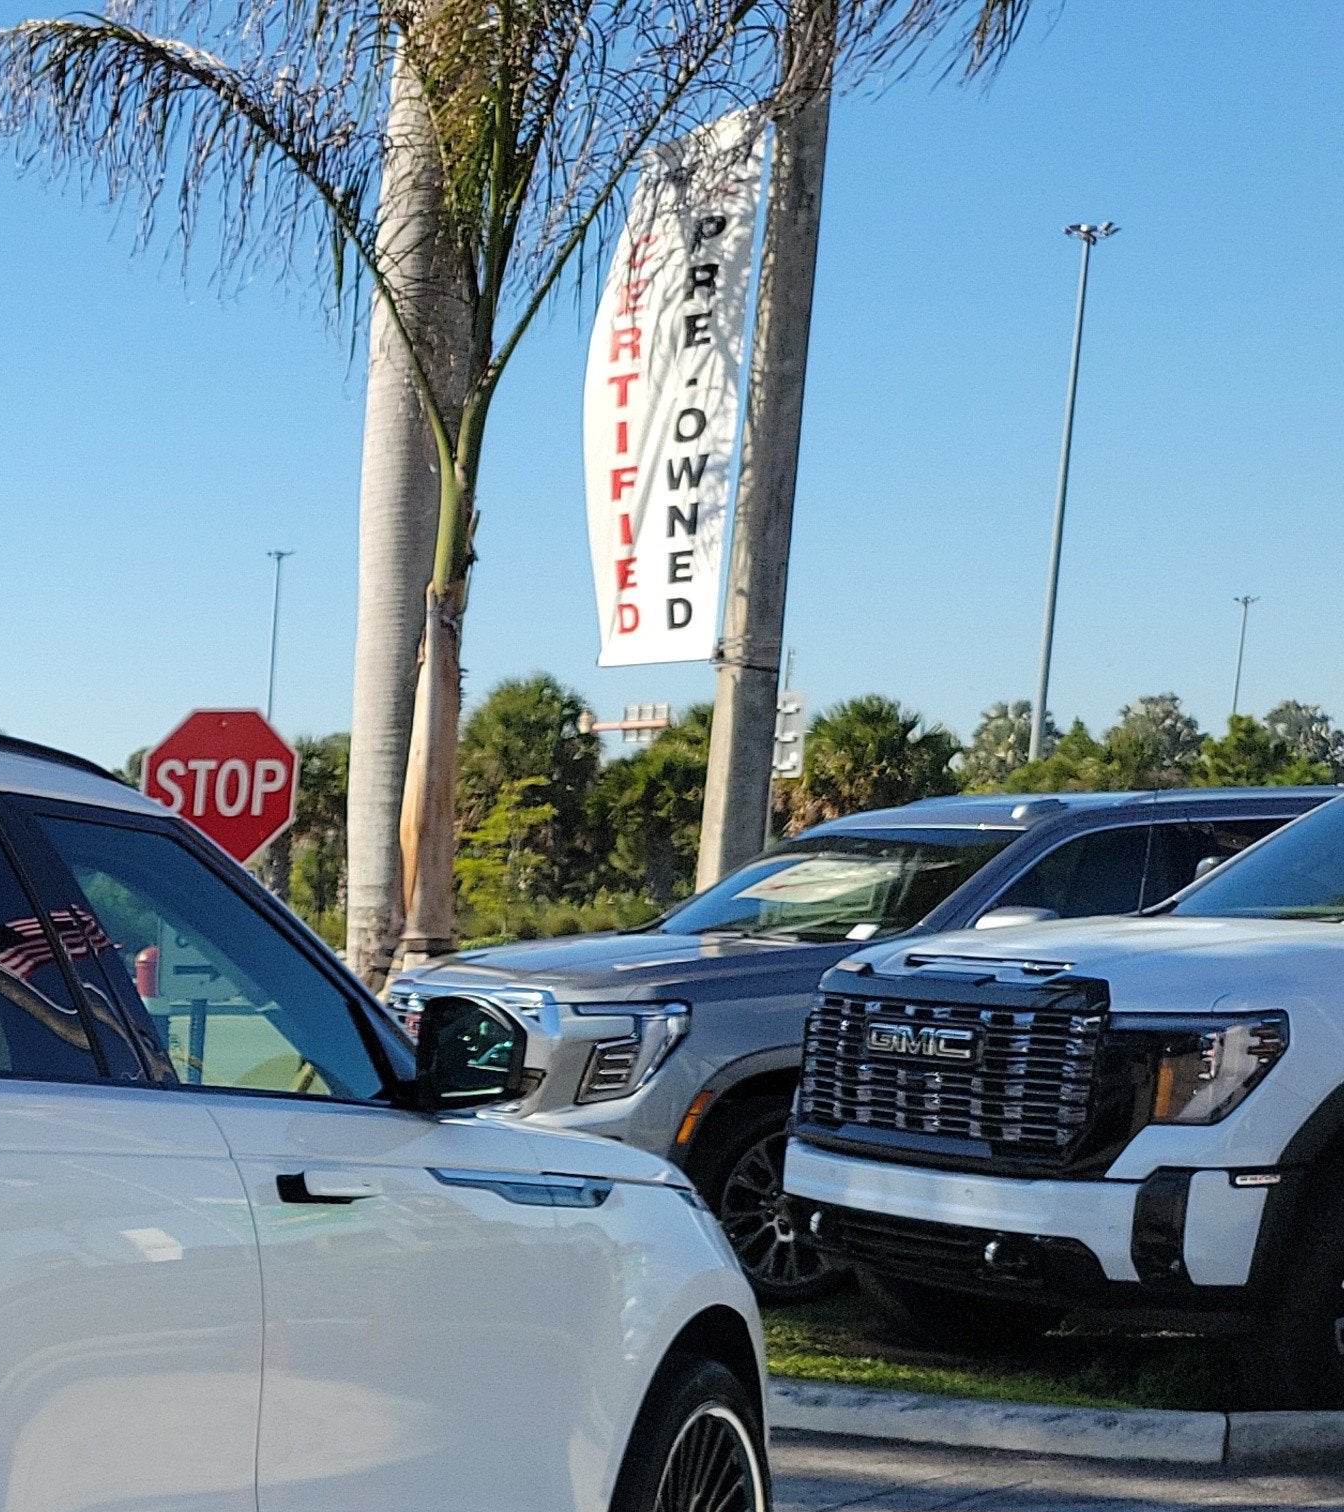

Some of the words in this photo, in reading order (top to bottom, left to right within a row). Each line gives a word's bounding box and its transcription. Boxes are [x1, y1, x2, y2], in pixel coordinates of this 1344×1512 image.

[607, 234, 658, 634] CERTIFIED
[155, 758, 289, 818] STOP
[867, 1022, 973, 1059] GMC
